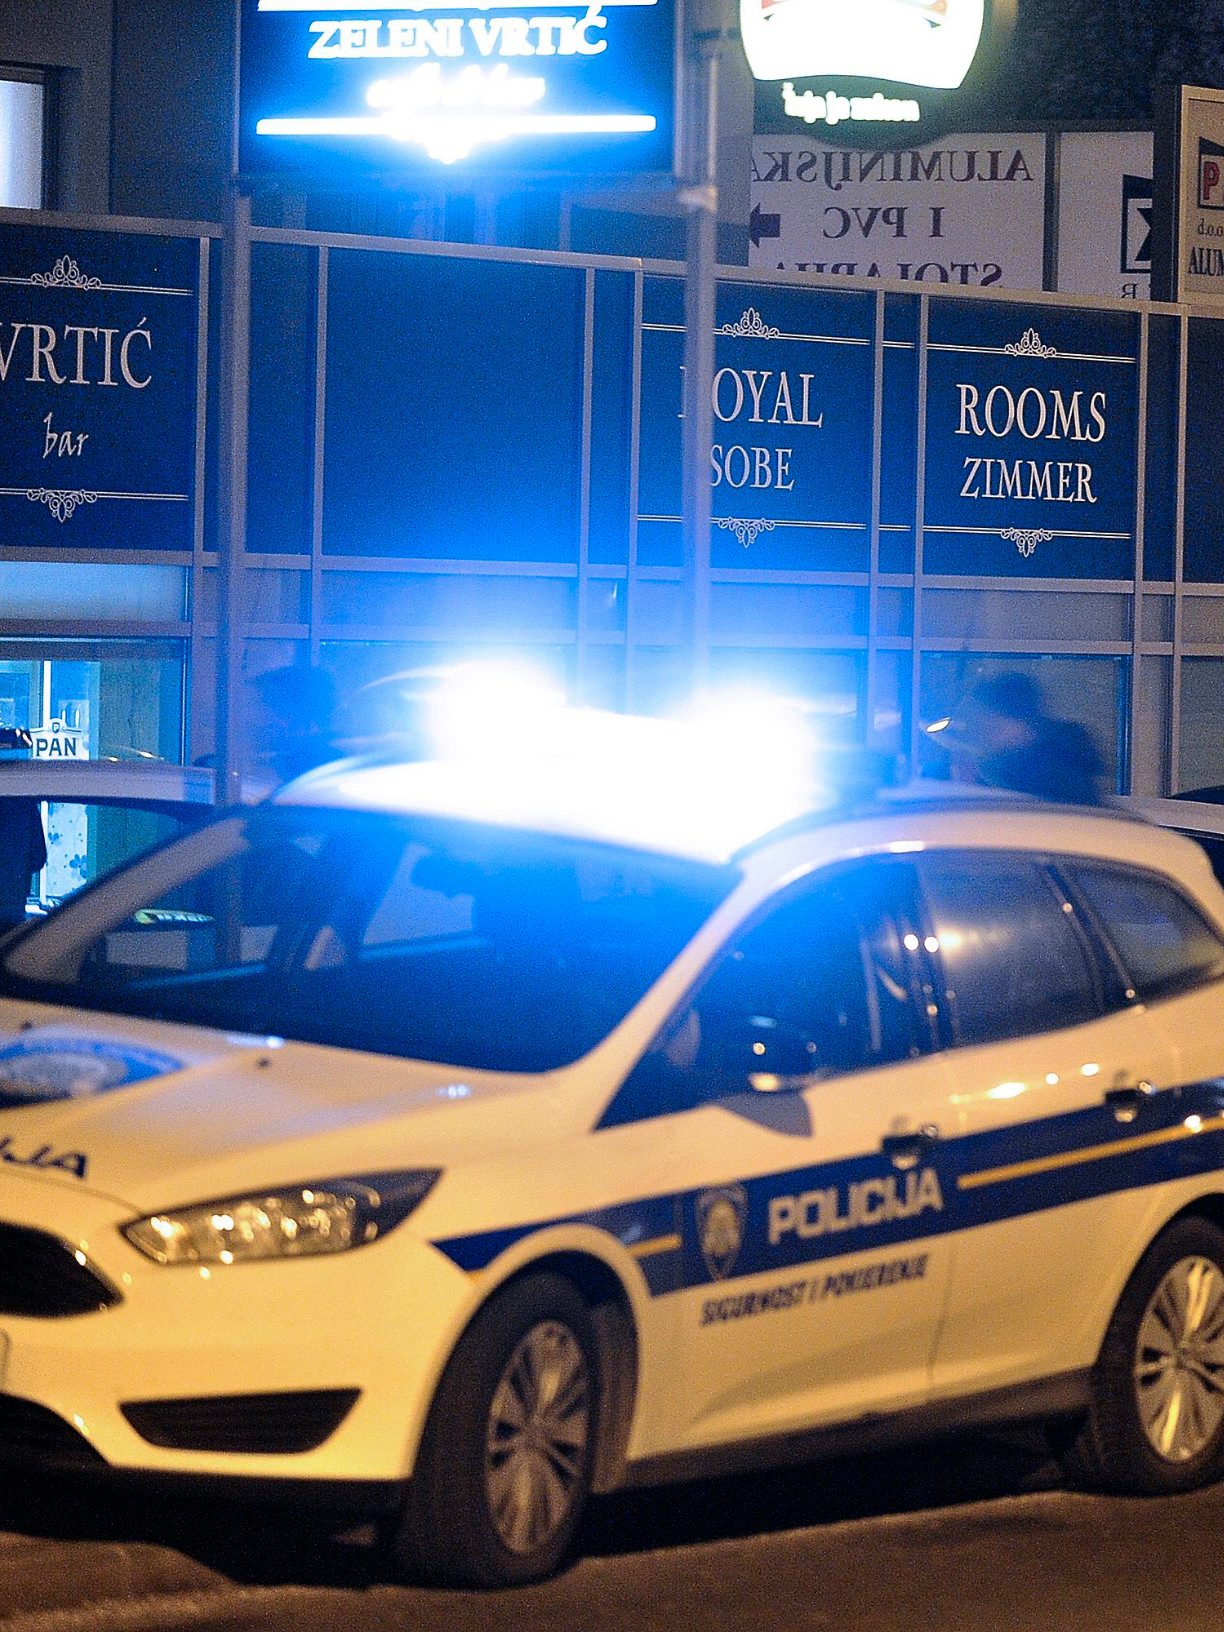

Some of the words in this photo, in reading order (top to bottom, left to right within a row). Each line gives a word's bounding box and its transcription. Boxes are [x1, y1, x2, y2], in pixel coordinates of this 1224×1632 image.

[308, 18, 464, 58] ZELENI
[469, 5, 608, 56] VRTIĆ
[0, 316, 152, 389] VRTIĆ
[678, 365, 823, 428] OYAL
[954, 383, 1107, 443] ROOMS
[42, 411, 89, 459] bar
[709, 443, 796, 492] SOBE
[959, 456, 1097, 503] ZIMMER
[36, 737, 77, 757] PAN
[768, 1167, 943, 1246] POLICIJA
